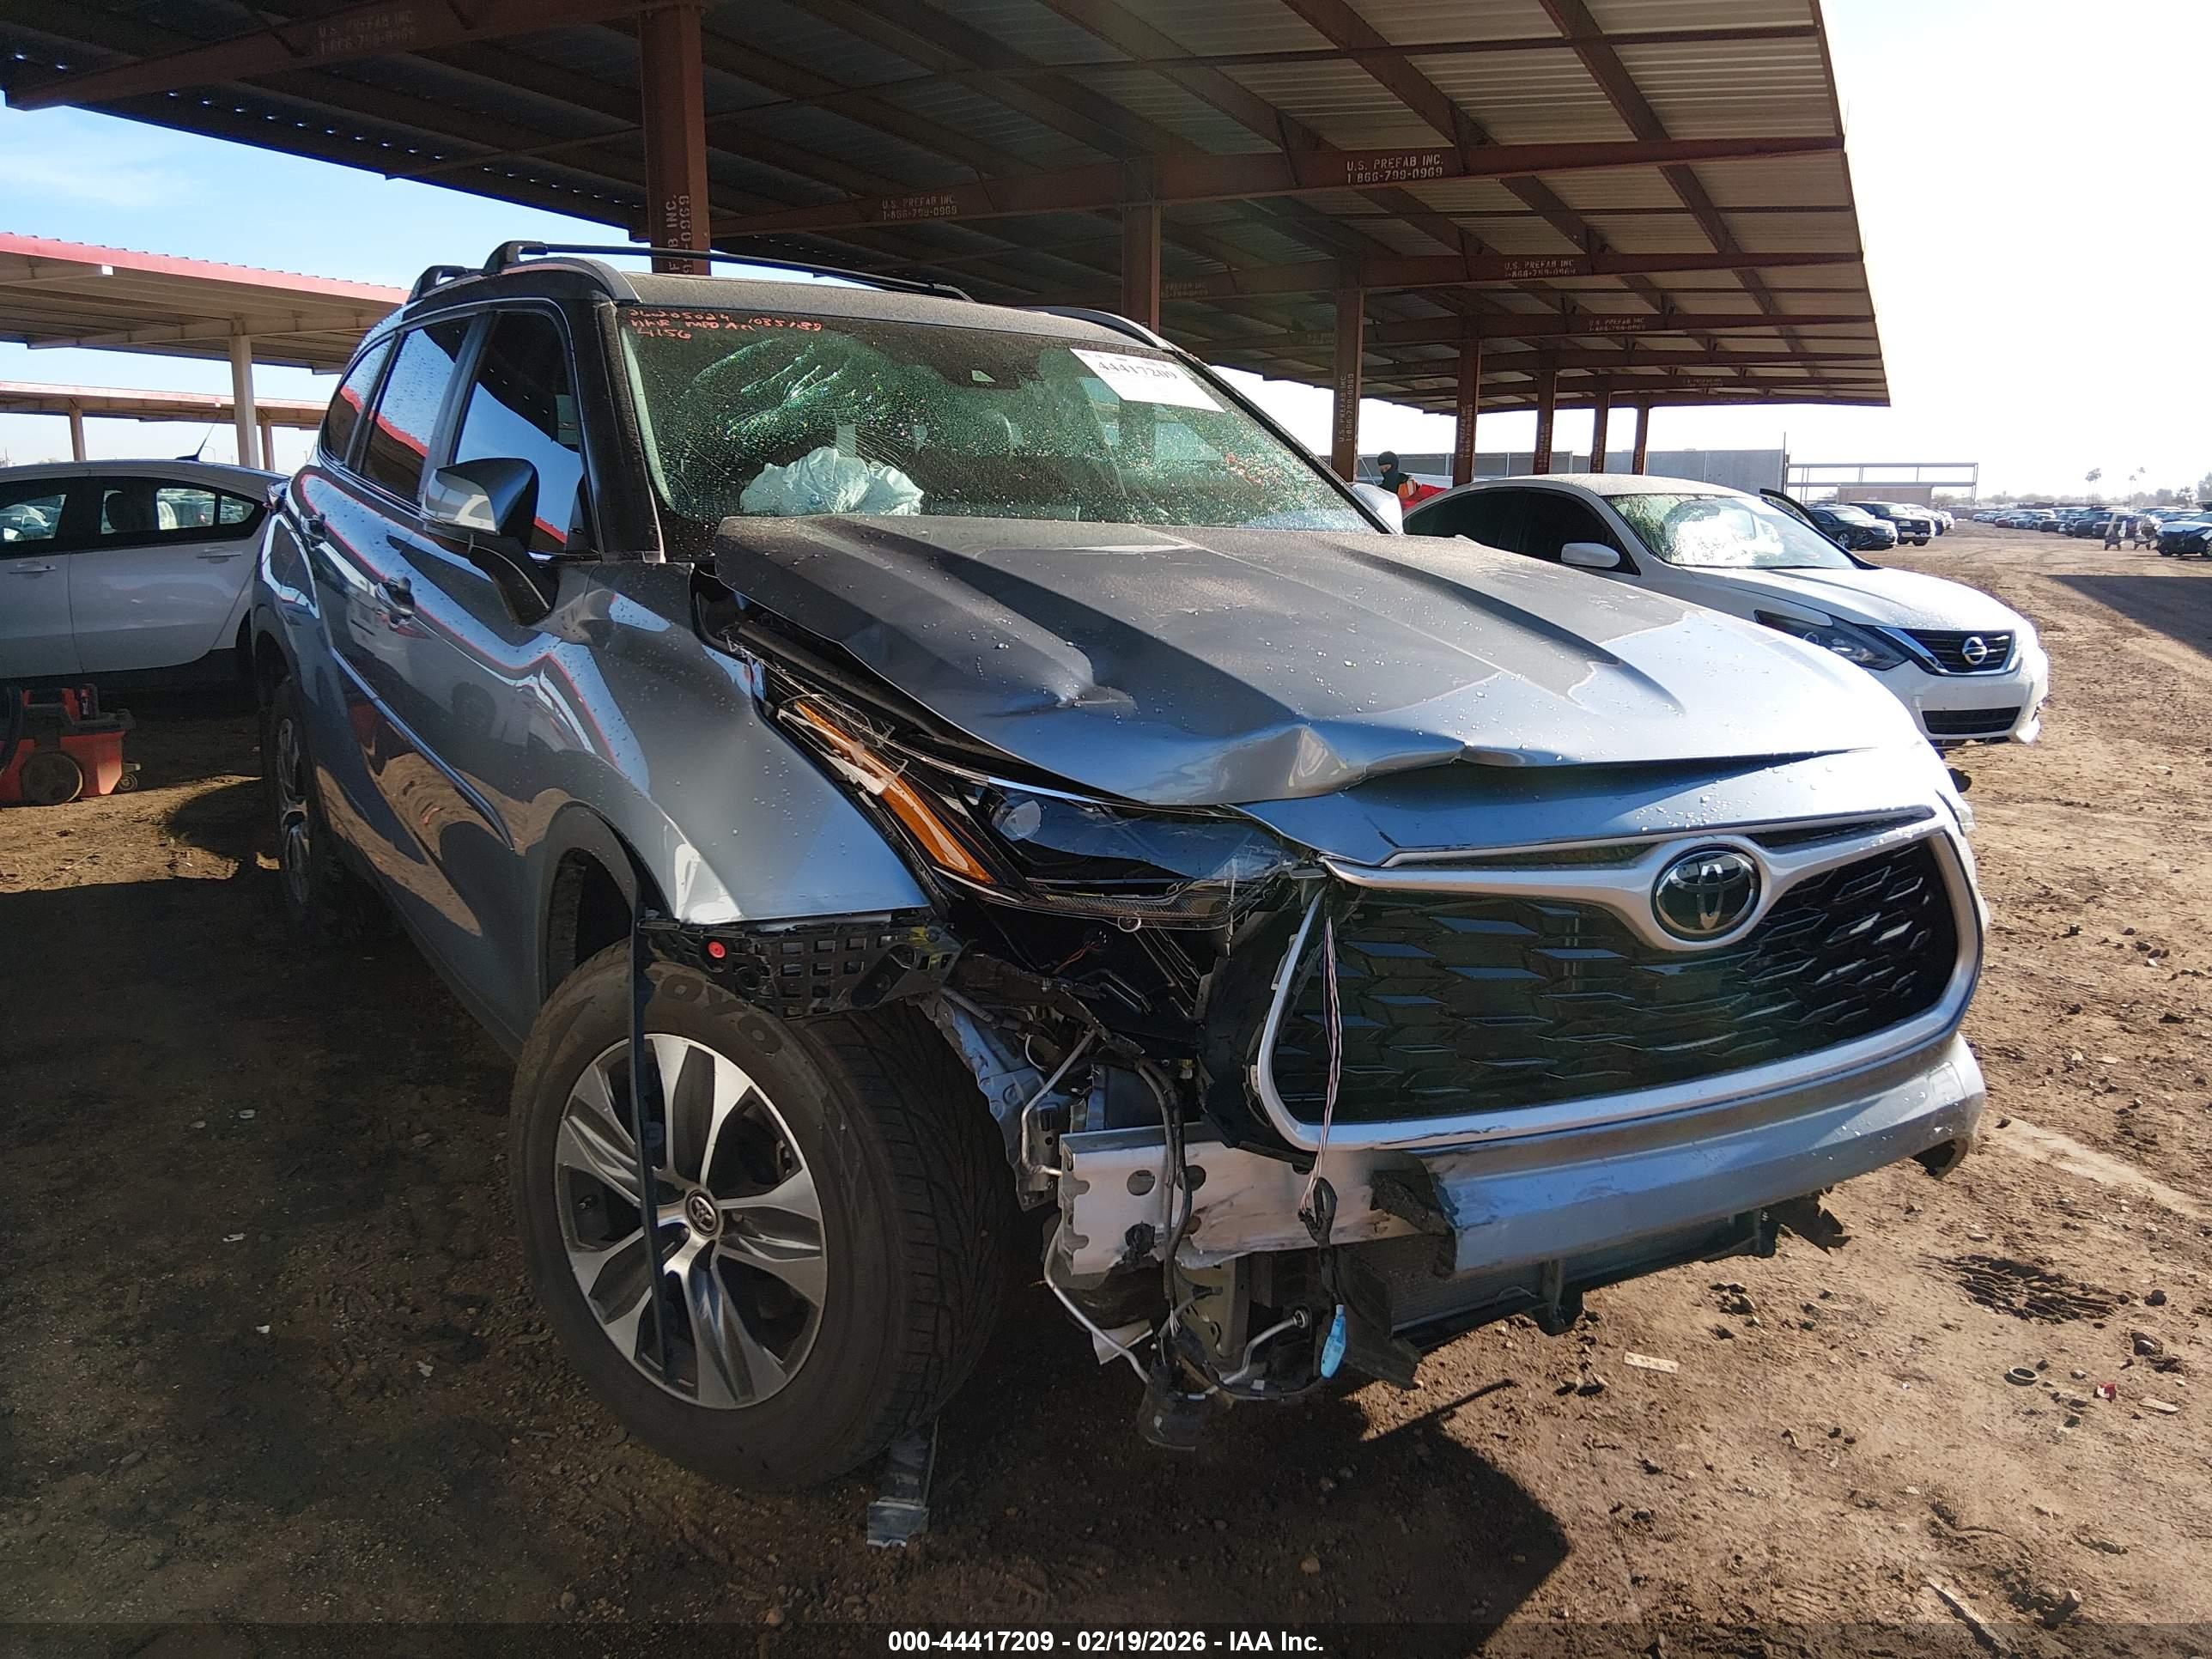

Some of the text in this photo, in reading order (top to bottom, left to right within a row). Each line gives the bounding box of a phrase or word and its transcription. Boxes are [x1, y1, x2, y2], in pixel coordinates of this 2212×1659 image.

[1346, 154, 1443, 172] U.S. PREFAB INC.
[665, 194, 678, 228] INC.
[1524, 260, 1557, 269] PREFAB
